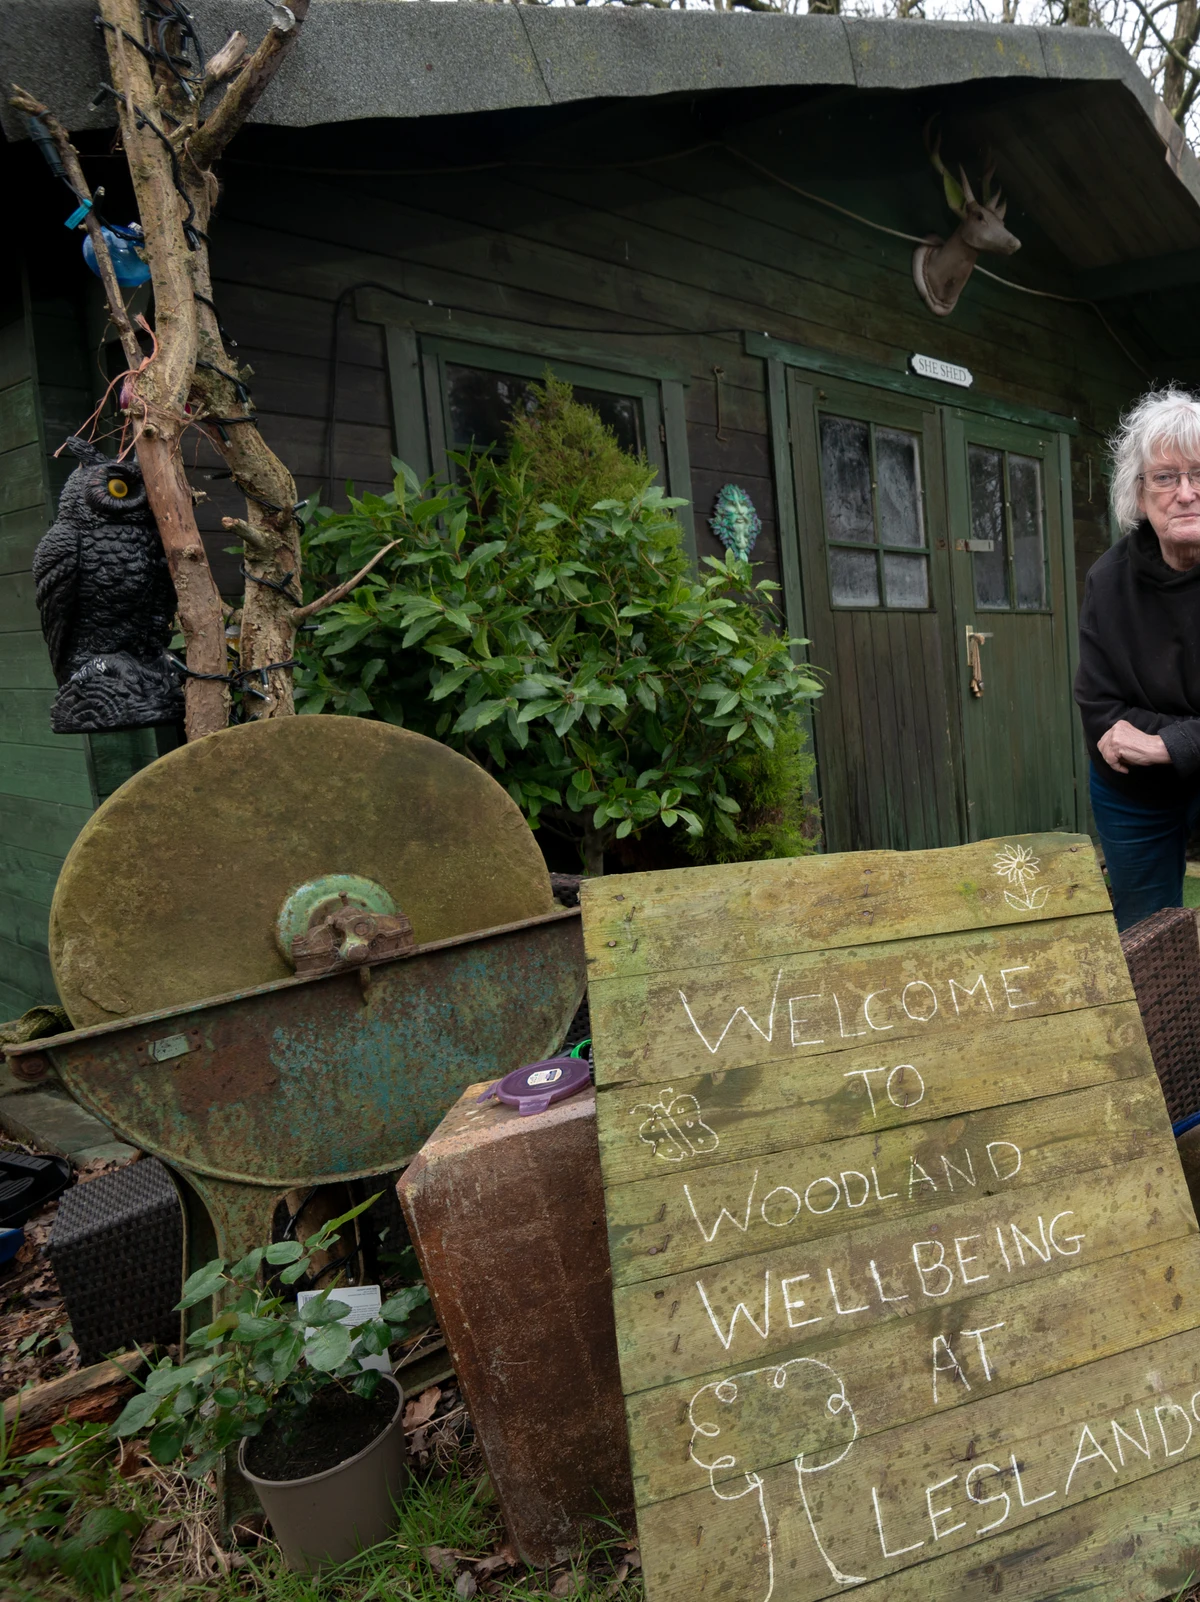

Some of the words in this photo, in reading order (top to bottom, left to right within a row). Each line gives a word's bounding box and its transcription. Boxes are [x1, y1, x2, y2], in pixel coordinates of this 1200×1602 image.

[919, 358, 939, 374] SHE
[940, 364, 967, 382] SHED
[678, 967, 1037, 1053] WELCOME
[842, 1063, 926, 1118] TO
[682, 1140, 1023, 1243] WOODLAND
[696, 1210, 1086, 1349] WELLBEING
[932, 1322, 1006, 1405] AT
